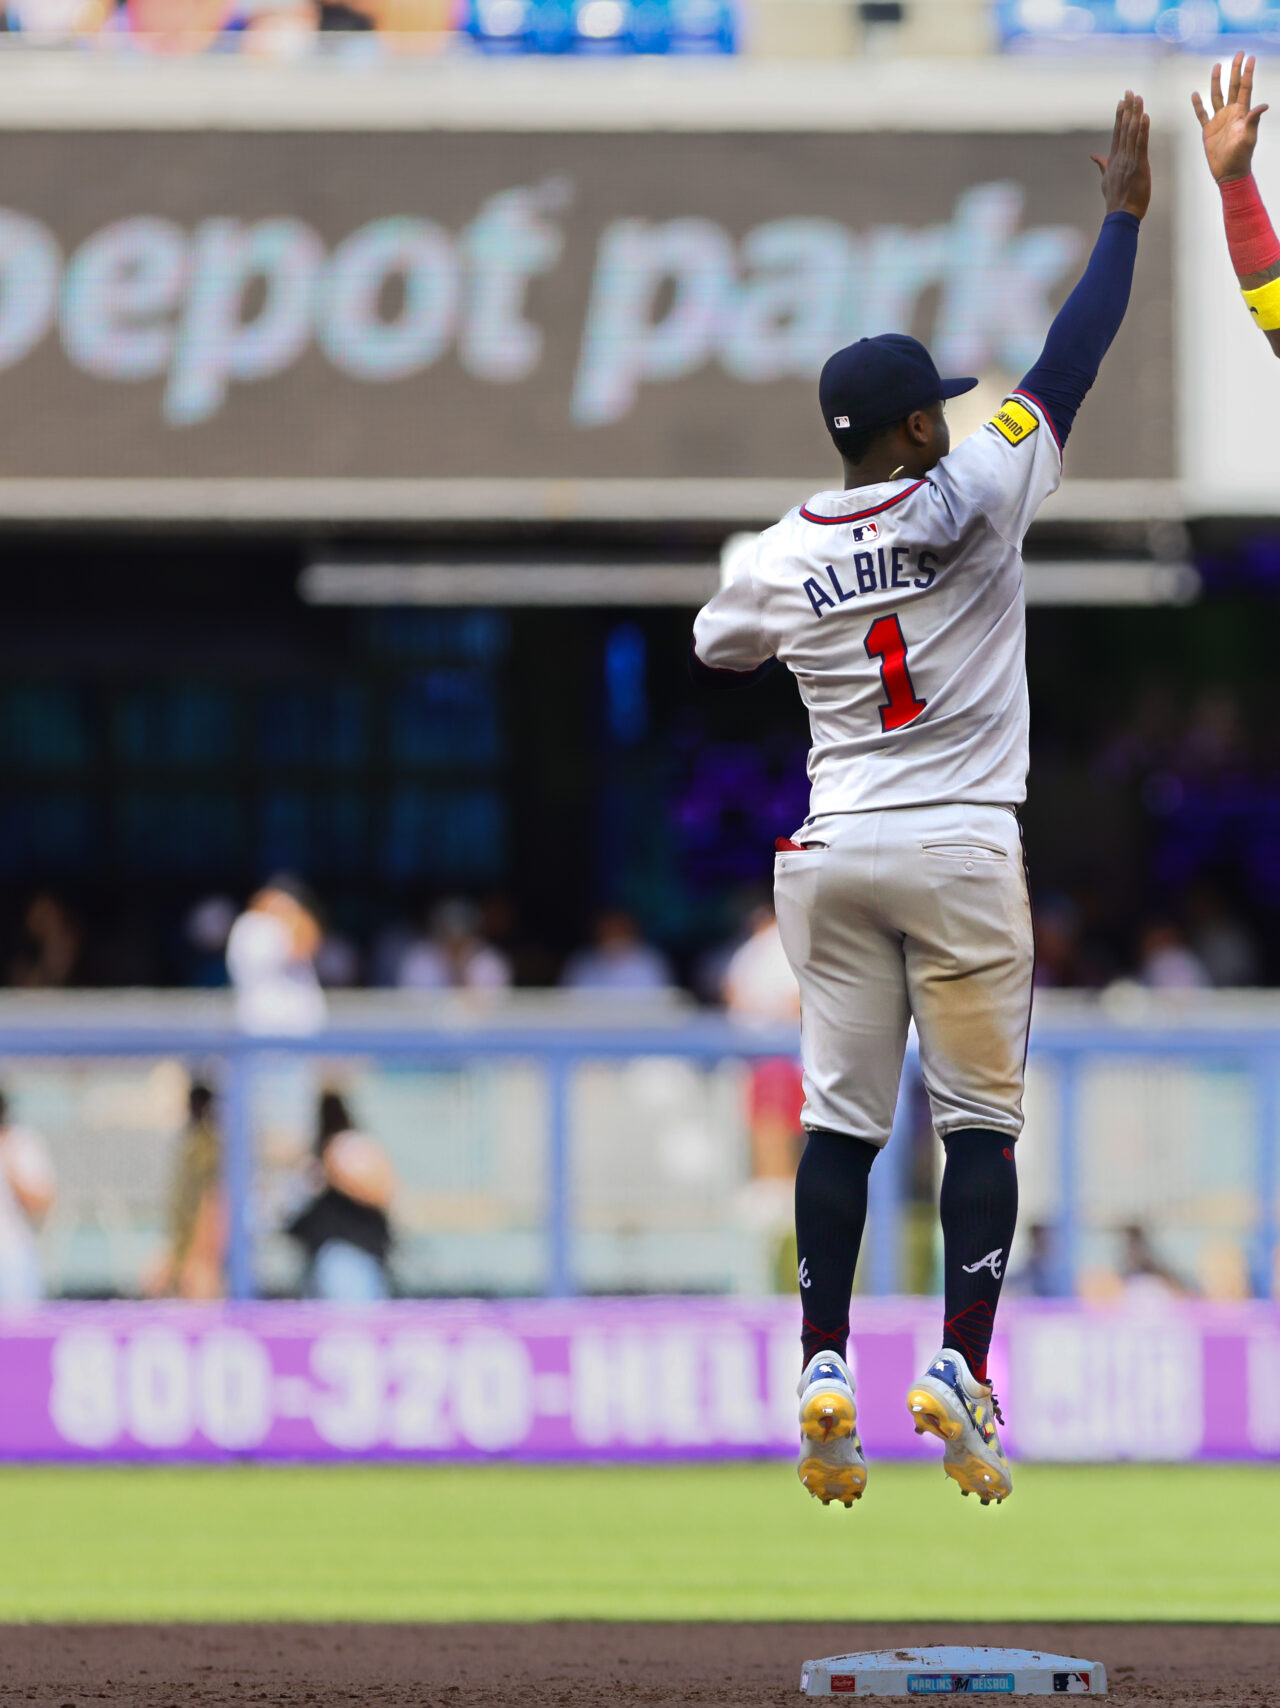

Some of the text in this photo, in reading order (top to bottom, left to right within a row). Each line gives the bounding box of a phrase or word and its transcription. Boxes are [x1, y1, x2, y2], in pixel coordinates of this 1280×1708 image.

[568, 180, 1082, 427] park
[802, 547, 939, 618] ALBIES
[863, 613, 928, 733] 1
[911, 1678, 953, 1691] MARLINS
[972, 1678, 1010, 1690] BEISBOL
